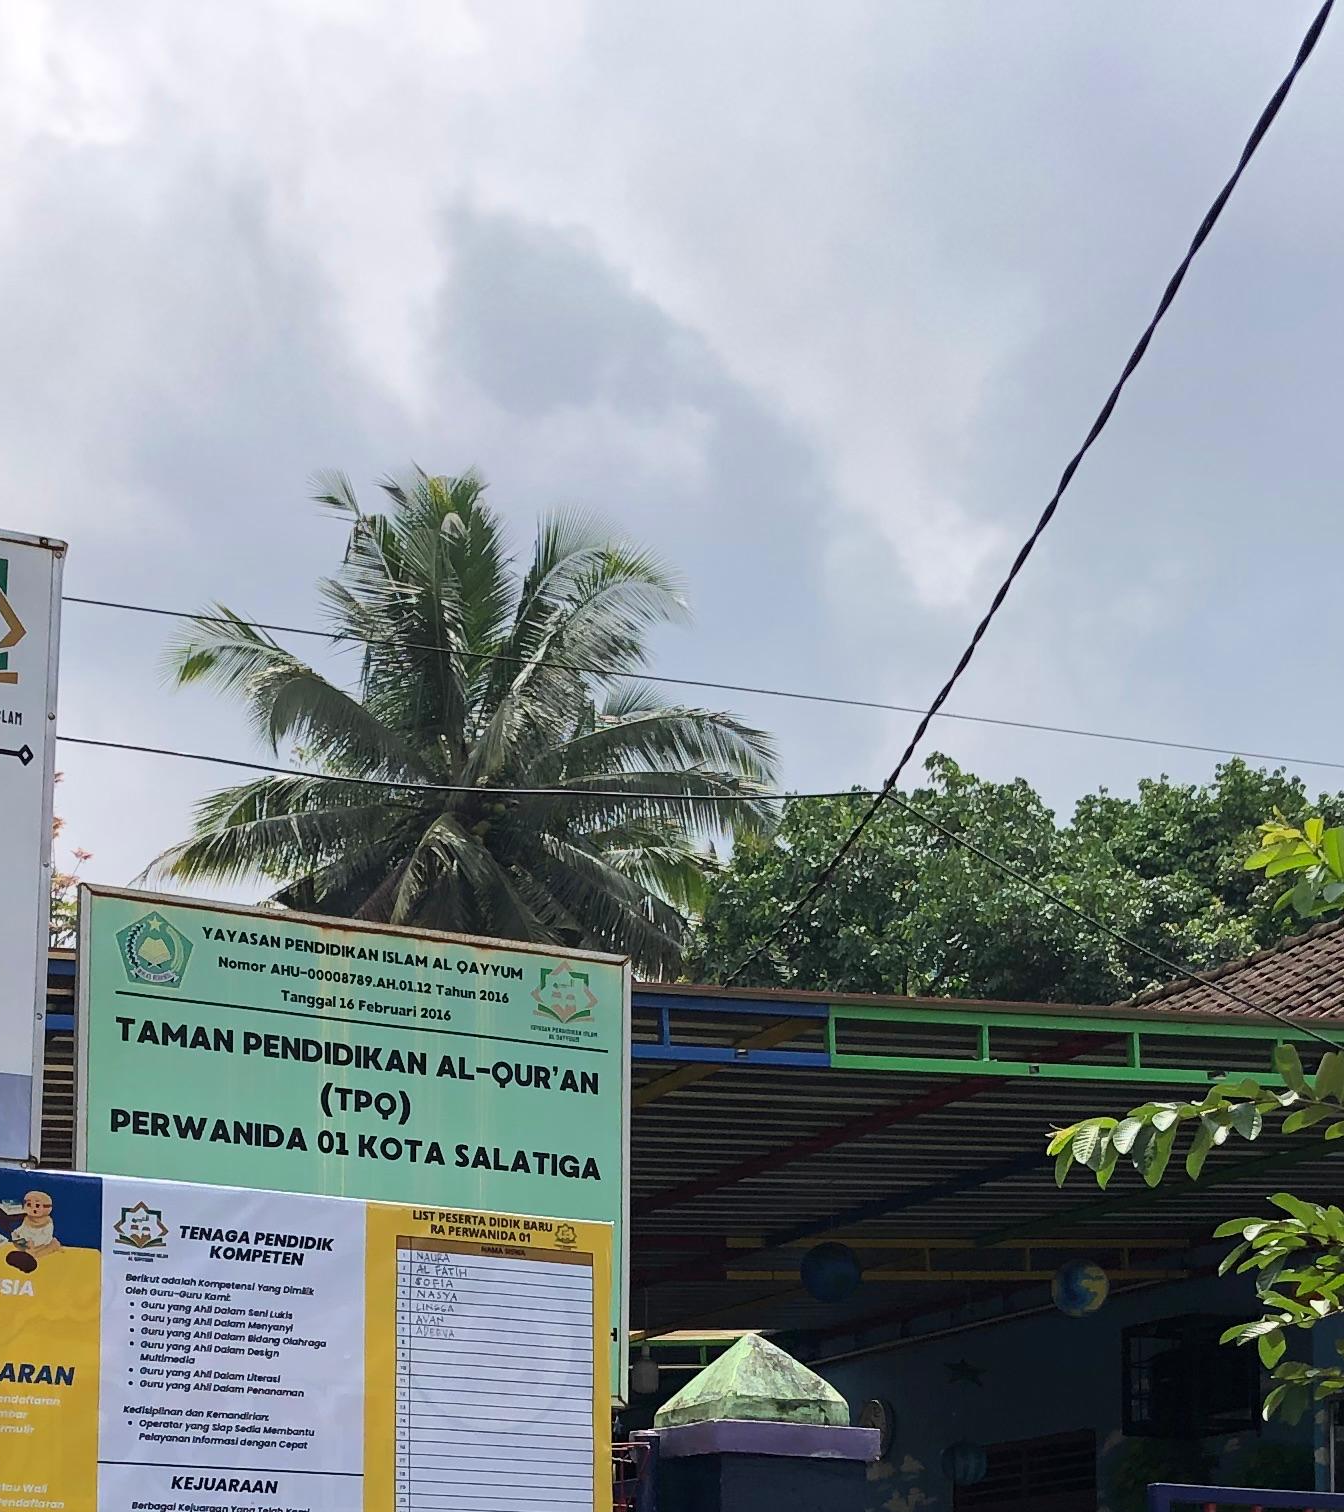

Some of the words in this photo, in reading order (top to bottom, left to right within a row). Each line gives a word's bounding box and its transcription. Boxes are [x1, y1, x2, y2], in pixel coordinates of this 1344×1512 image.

[202, 926, 280, 948] YAYASAN
[284, 937, 378, 961] PENDIDIKAN
[382, 950, 428, 968] ISLAM
[432, 957, 452, 970] AL
[456, 960, 522, 980] QAYYUM
[218, 955, 266, 972] Nomor
[270, 963, 431, 994] AHU-00008789.AH.01.12
[435, 983, 476, 999] Tahun
[479, 989, 509, 1003] 2016
[280, 989, 336, 1009] Tanggal
[339, 997, 354, 1010] 16
[358, 999, 416, 1017] Februari
[420, 1007, 451, 1021] 2016
[115, 1015, 233, 1053] TAMAN
[243, 1031, 426, 1075] PENDIDIKAN
[436, 1054, 598, 1095] AL-QUR'AN
[320, 1082, 410, 1125] (TPQ)
[110, 1108, 307, 1151] PERWANIDA
[317, 1129, 349, 1155] 01
[358, 1133, 445, 1165] KOTA
[454, 1143, 601, 1180] SALATIGA
[412, 1209, 435, 1221] LIST
[438, 1212, 486, 1226] PESERTA
[489, 1216, 520, 1229] DIDIK
[523, 1220, 552, 1232] BARU
[430, 1223, 445, 1235] RA
[448, 1225, 516, 1241] PERWANIDA
[518, 1231, 530, 1243] 01
[179, 1225, 251, 1246] TENAGA
[254, 1230, 334, 1252] PENDIDIK
[209, 1244, 304, 1267] KOMPETEN
[170, 1475, 278, 1494] KEJUARAAN
